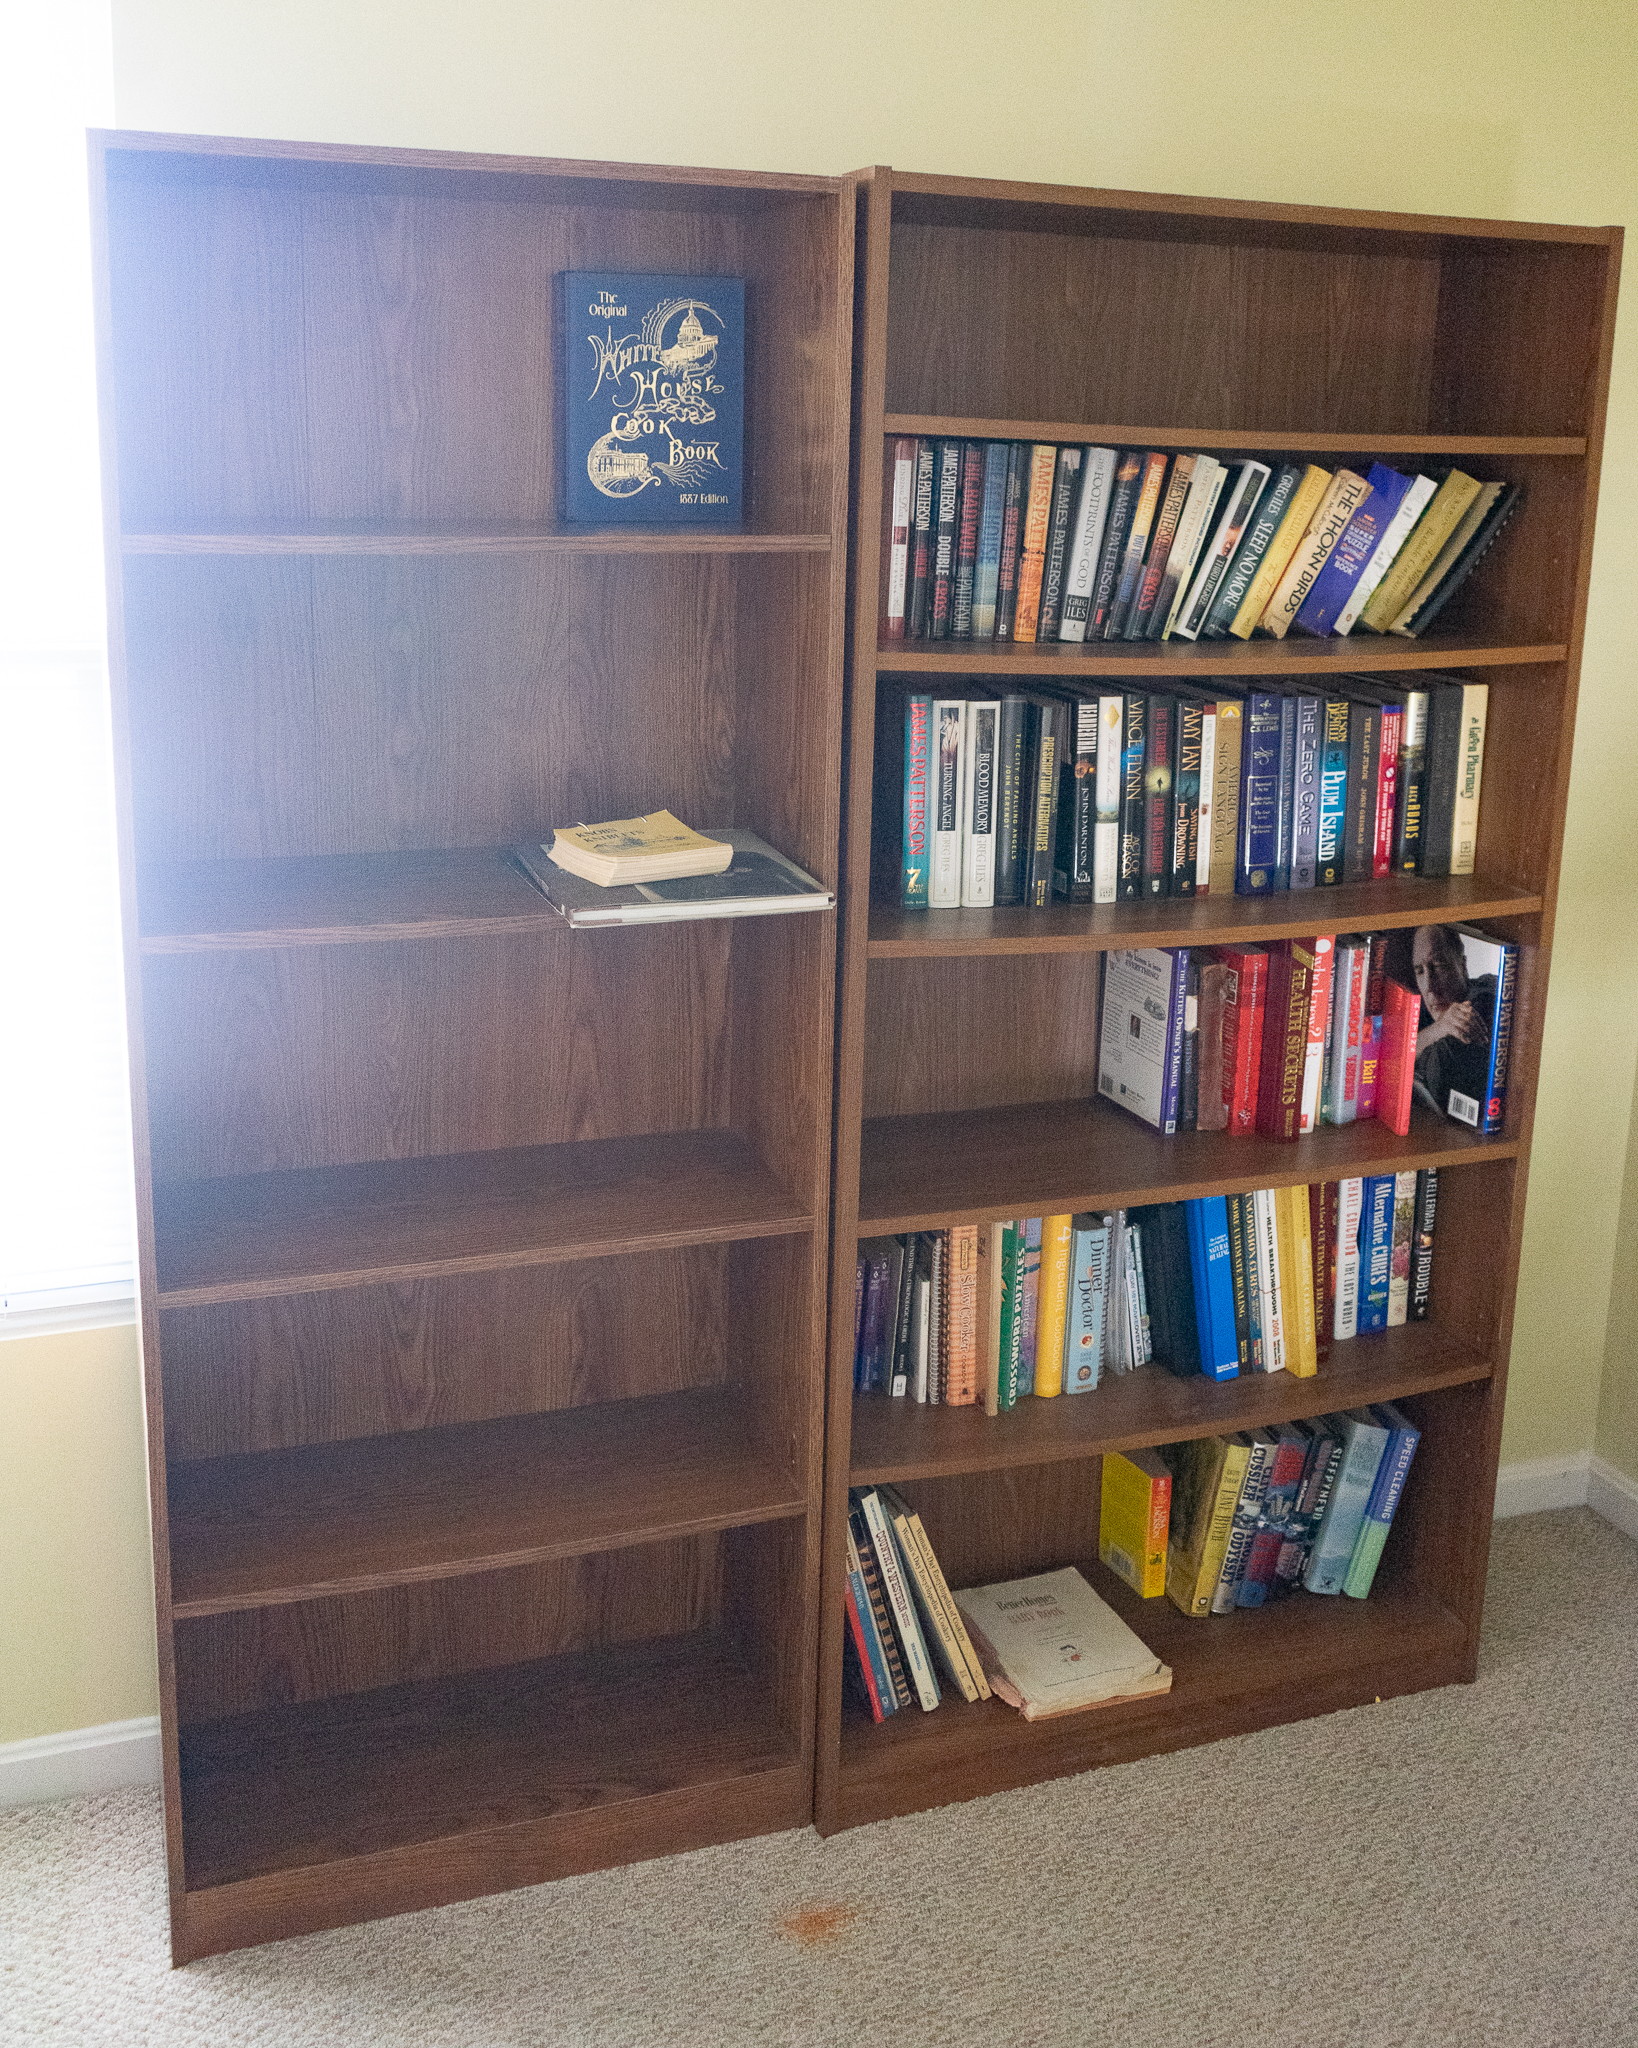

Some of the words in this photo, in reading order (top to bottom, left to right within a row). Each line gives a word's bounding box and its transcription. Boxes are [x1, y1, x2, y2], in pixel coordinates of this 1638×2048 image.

[588, 304, 627, 319] Original
[598, 291, 618, 304] The
[611, 412, 677, 442] COOK
[669, 439, 728, 470] BOOK
[919, 450, 933, 479] JAMES
[942, 448, 958, 475] JAMES
[1035, 454, 1053, 508] JAMES
[1147, 462, 1163, 487] JAMES
[1171, 469, 1189, 500] JAMES
[1272, 474, 1294, 498] GREG
[679, 494, 698, 504] 1887
[700, 494, 729, 504] Edition
[916, 481, 932, 530] PATTERSON
[939, 476, 956, 522] PATTERSON
[1056, 484, 1071, 525] JAMES
[1083, 472, 1104, 547] FOOTPRINTS
[1113, 488, 1130, 528] JAMES
[1267, 497, 1286, 515] ILES
[1337, 482, 1363, 515] THE
[1156, 500, 1180, 553] PATTERSON
[1249, 519, 1274, 553] SLEEP
[1308, 514, 1346, 571] THORN
[1342, 534, 1370, 554] PUZZLE
[936, 536, 951, 575] DOUBLE
[1045, 530, 1065, 606] PATTERSON
[1076, 559, 1088, 588] GOD
[1097, 531, 1121, 604] PATTERSON
[1208, 560, 1225, 583] THIRD
[1240, 552, 1258, 573] NO
[1334, 560, 1354, 576] BOOK
[933, 580, 948, 619] CROSS
[954, 579, 973, 631] PATTERSON
[1068, 598, 1088, 608] GREG
[1138, 569, 1160, 610] CROSS
[1199, 581, 1218, 607] DEGREE
[1223, 572, 1246, 609] MORE
[1284, 570, 1314, 615] BIRDS
[1066, 607, 1086, 619] ILES
[909, 703, 927, 756] JAMES
[1077, 704, 1098, 754] NEANDERTHAL
[1128, 701, 1144, 747] VINCE
[1183, 707, 1202, 740] AMY
[1285, 705, 1294, 728] MARY
[1302, 701, 1318, 734] THE
[1326, 703, 1340, 743] DEMILLE
[1339, 702, 1348, 742] NELSON
[1364, 717, 1372, 733] THE
[1182, 745, 1202, 771] TAN
[1218, 742, 1228, 775] SIGN
[1284, 731, 1293, 766] HIGGINS
[1300, 740, 1315, 784] ZERO
[1363, 735, 1371, 754] LAST
[942, 760, 953, 801] TURNING
[978, 753, 990, 788] BLOOD
[1014, 776, 1019, 785] OF
[1039, 736, 1055, 794] PRESCRIPTION
[1126, 754, 1142, 800] FLYNN
[1283, 768, 1291, 798] CLARK
[1362, 756, 1370, 779] JUROR
[1081, 788, 1089, 813] JOHN
[1226, 764, 1239, 837] AMERICAN
[1321, 770, 1346, 806] PLUM
[1409, 785, 1418, 802] BACK
[909, 758, 926, 855] PATTERSON
[941, 802, 953, 830] ANGEL
[976, 789, 989, 833] MEMORY
[1036, 796, 1051, 851] ALTERNATIVES
[1179, 803, 1188, 817] from
[1189, 809, 1199, 840] SAVING
[1213, 779, 1227, 858] LANGUAGE
[1299, 791, 1315, 836] GAME
[1405, 804, 1421, 839] ROADS
[975, 836, 987, 863] GREG
[1080, 815, 1089, 866] DARNTON
[1176, 819, 1190, 869] DROWNING
[1189, 842, 1198, 860] FISH
[1319, 811, 1343, 861] ISLAND
[1122, 832, 1133, 879] TREASON
[906, 866, 922, 889] 7
[1501, 953, 1517, 1000] JAMES
[1176, 984, 1186, 1014] KITTEN
[1288, 967, 1306, 1031] HEALTH
[1173, 1017, 1183, 1053] OWNER'S
[1410, 1002, 1420, 1052] KITTENS
[1494, 1003, 1512, 1088] PATTERSON
[1170, 1055, 1180, 1089] MANUAL
[1282, 1035, 1301, 1105] SECRETS
[1362, 1060, 1377, 1084] Bait
[1231, 1199, 1242, 1225] MORE
[1347, 1181, 1359, 1208] CHAEL
[1424, 1178, 1438, 1231] KELLERMAN
[1245, 1193, 1257, 1258] UNCOMMON
[1266, 1216, 1274, 1246] HEALTH
[1372, 1183, 1392, 1245] Alternative
[1057, 1226, 1072, 1244] 4
[1233, 1227, 1244, 1274] ULTIMATE
[1345, 1212, 1357, 1256] CRICHTON
[1014, 1248, 1025, 1313] PUZZLES
[1054, 1249, 1068, 1312] Ingredient
[1090, 1240, 1105, 1294] Dinner
[1250, 1261, 1258, 1297] CURES
[1268, 1248, 1278, 1315] BREAKTHROUGHS
[1345, 1262, 1356, 1275] THE
[1370, 1245, 1388, 1285] CURES
[1414, 1250, 1432, 1303] TROUBLE
[960, 1274, 975, 1305] Slow
[1078, 1279, 1094, 1330] Doctor
[1237, 1277, 1246, 1318] HEALING
[1344, 1280, 1355, 1296] LOST
[959, 1307, 975, 1352] Cooker
[1020, 1292, 1033, 1338] American
[1272, 1318, 1280, 1338] 2008
[1342, 1300, 1352, 1324] WORLD
[1008, 1316, 1021, 1406] CROSSWORD
[1052, 1317, 1062, 1372] Cookbook
[1396, 1435, 1415, 1469] SPEED
[1242, 1447, 1267, 1502] CUSSLER
[1255, 1466, 1273, 1502] CLIVE
[1312, 1449, 1342, 1520] SLEEPYHEAD
[1380, 1468, 1404, 1520] CLEANING
[876, 1530, 893, 1568] COUNTRY
[900, 1527, 917, 1556] Woman's
[914, 1527, 931, 1556] Woman's
[1220, 1531, 1245, 1585] ODYSSEY
[886, 1564, 893, 1573] &
[911, 1556, 922, 1569] Day
[925, 1555, 936, 1569] Day
[887, 1574, 908, 1613] WESTERN
[917, 1569, 939, 1611] Encyclopedia
[930, 1568, 953, 1610] Encyclopedia
[901, 1612, 910, 1628] MUSIC
[934, 1609, 942, 1617] of
[936, 1616, 952, 1642] Cookery
[950, 1615, 966, 1641] Cookery
